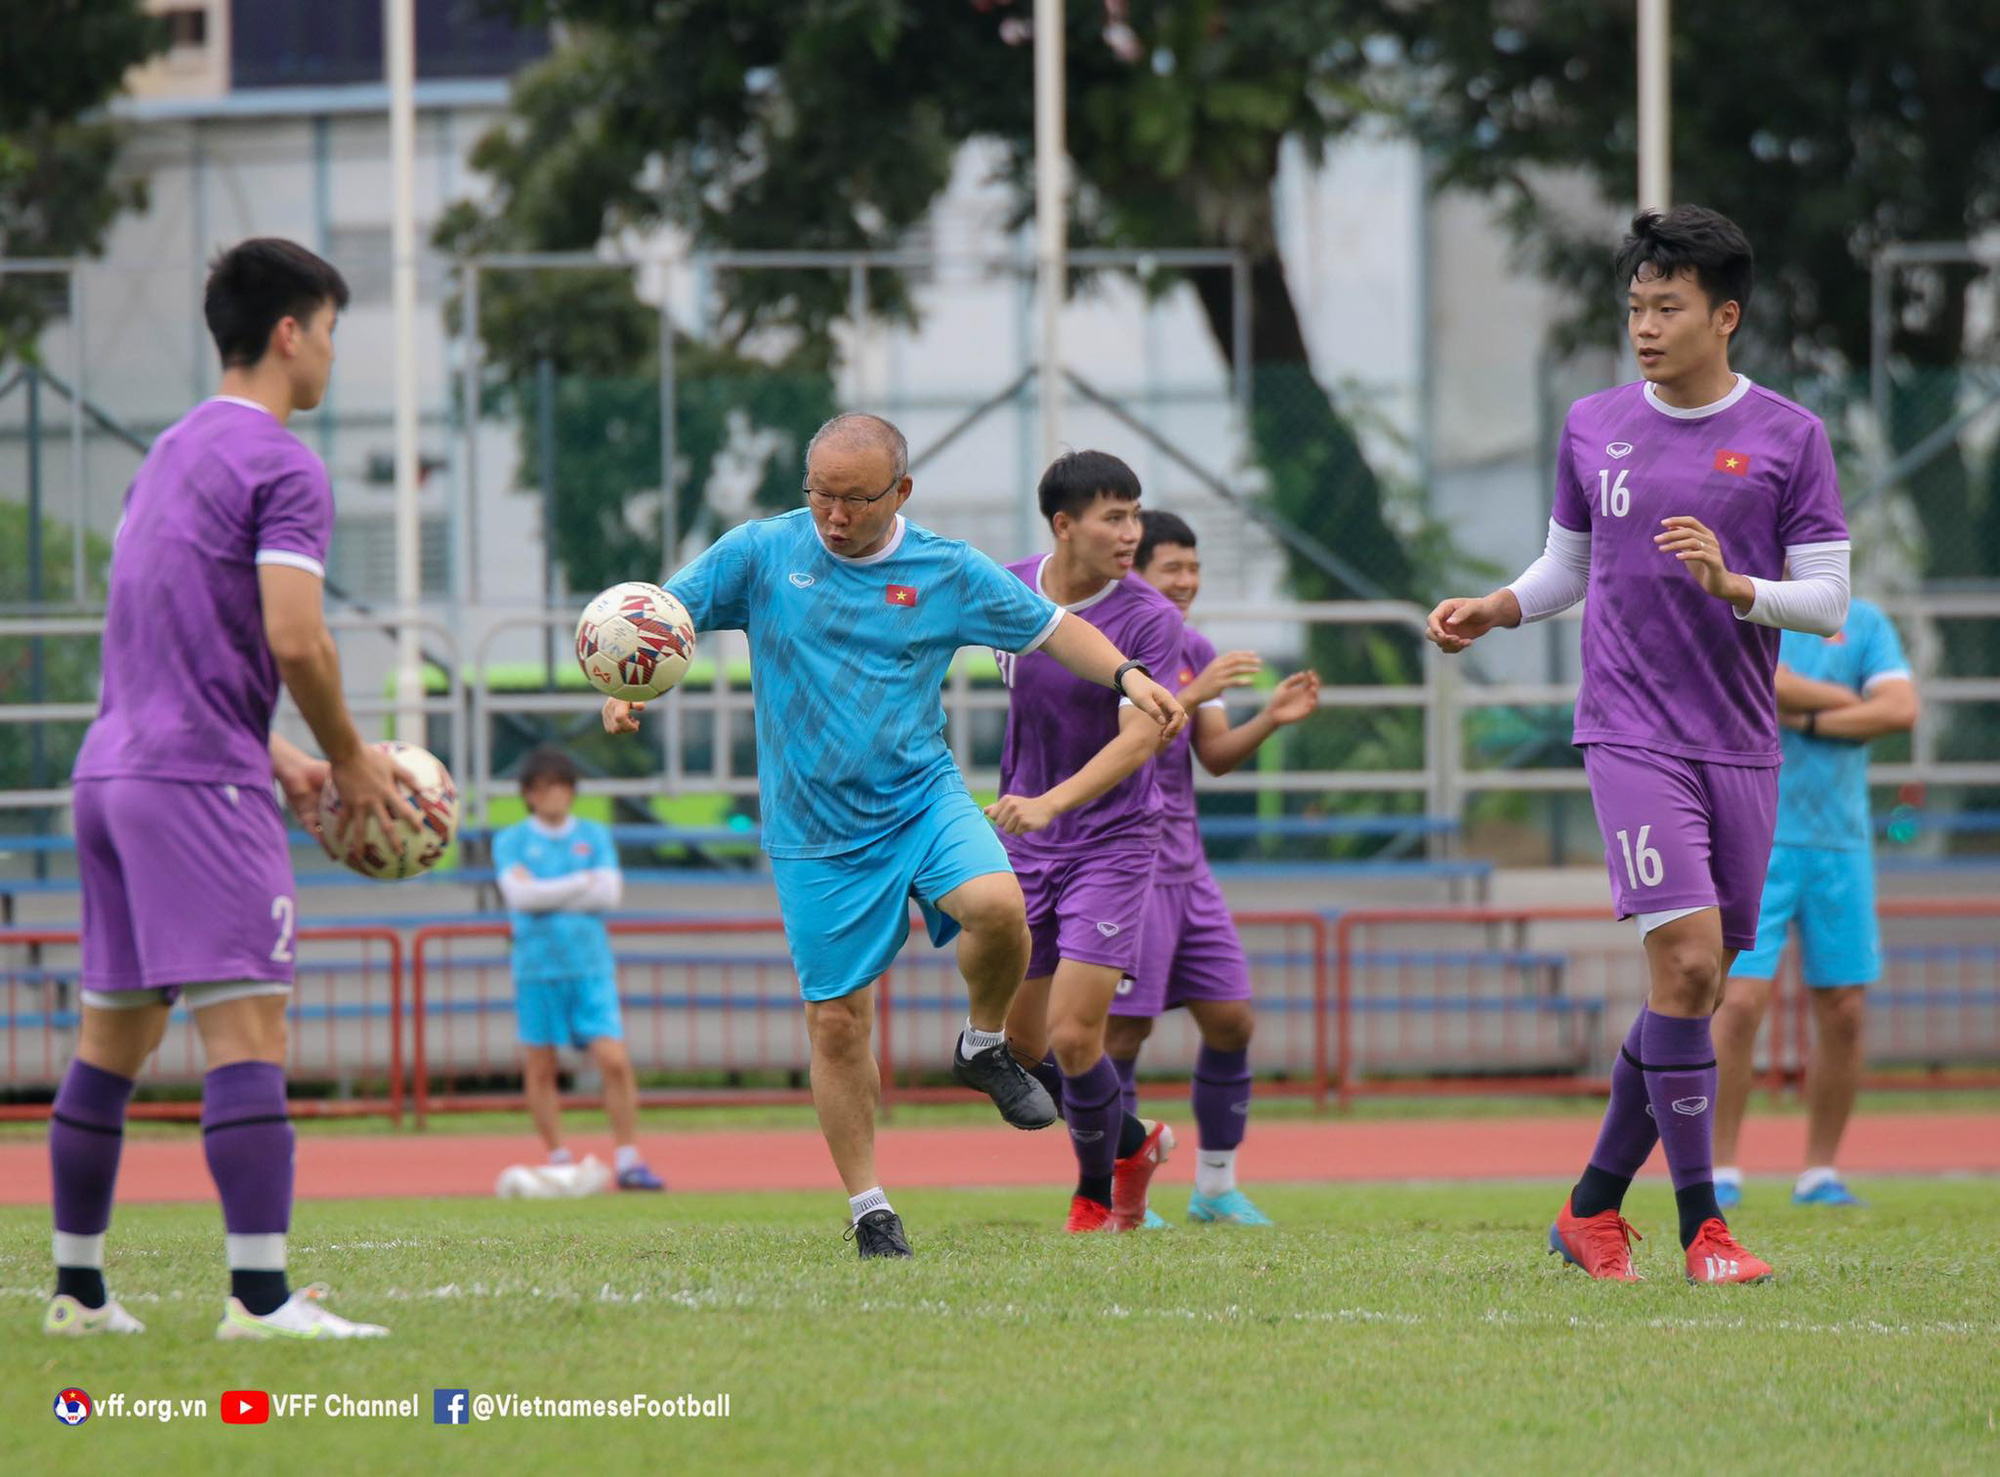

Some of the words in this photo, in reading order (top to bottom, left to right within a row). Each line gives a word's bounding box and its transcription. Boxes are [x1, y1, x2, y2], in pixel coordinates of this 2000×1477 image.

[1598, 469, 1631, 518] 16
[1616, 824, 1664, 890] 16
[270, 895, 294, 963] 2
